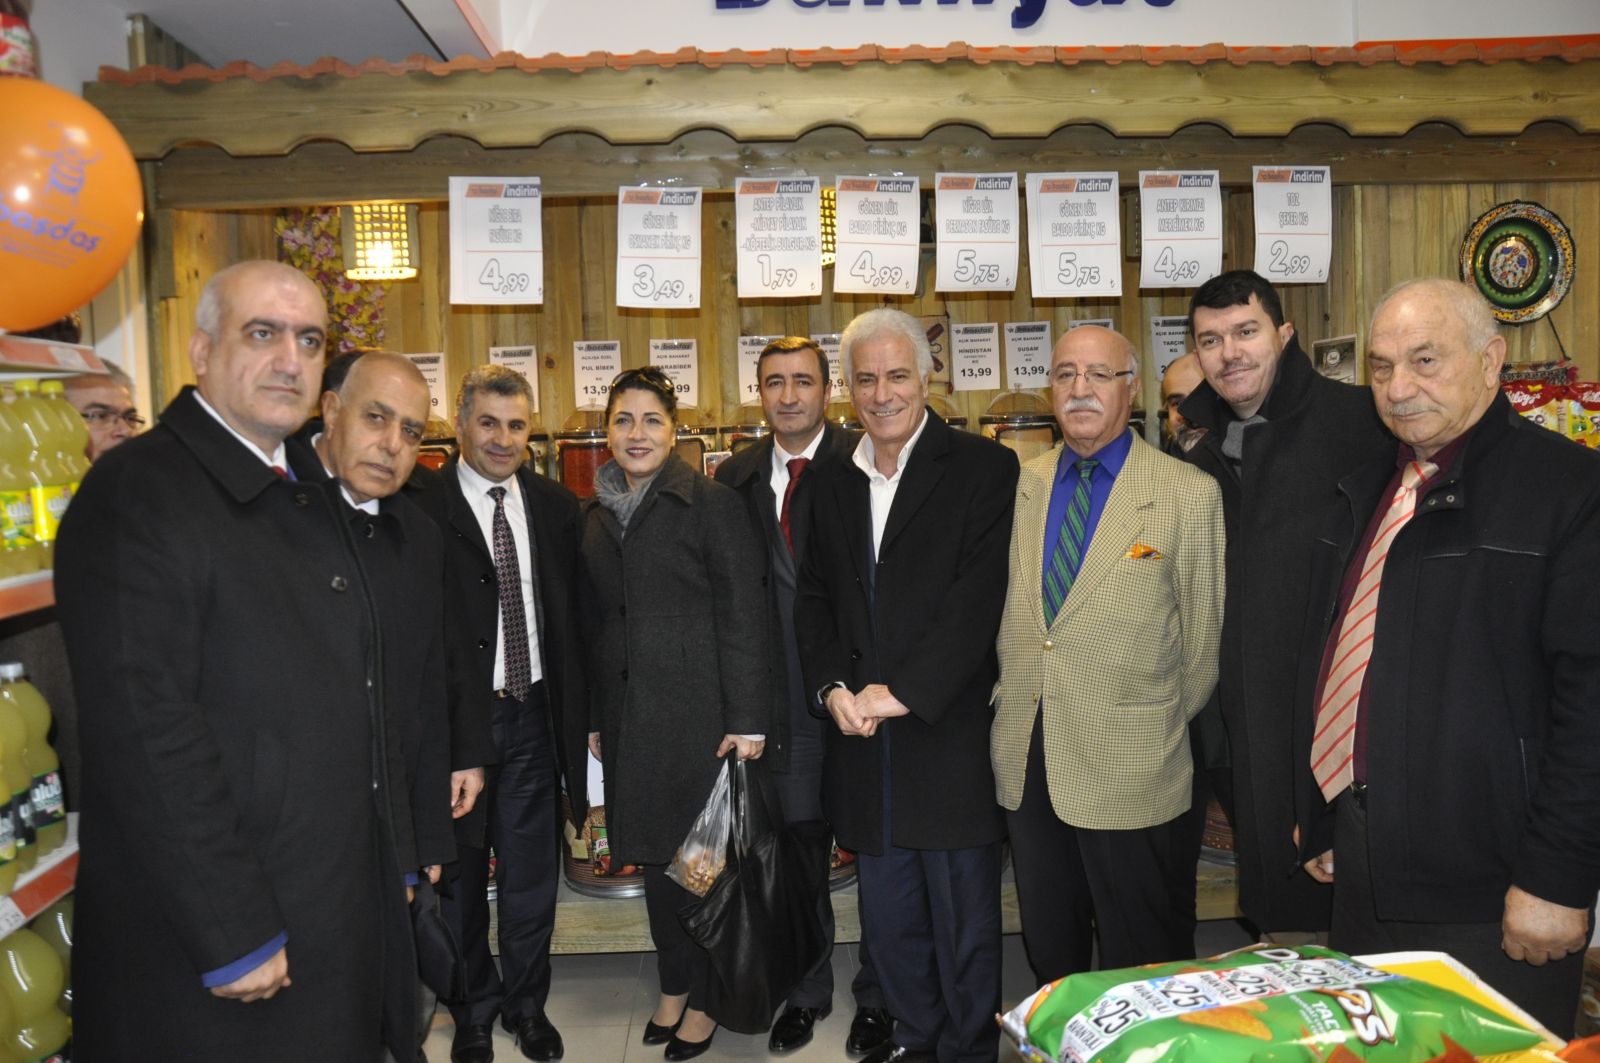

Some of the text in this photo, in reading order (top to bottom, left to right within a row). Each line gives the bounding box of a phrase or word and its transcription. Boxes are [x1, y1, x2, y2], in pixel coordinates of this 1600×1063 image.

[757, 254, 797, 290] 1,79
[850, 250, 902, 287] 4,99
[954, 249, 999, 285] 5,75
[1057, 252, 1101, 287] 5,75
[1154, 246, 1200, 281] 4,49
[1268, 240, 1310, 276] 2,99
[479, 258, 529, 295] 4,99
[632, 264, 684, 301] 3,49
[961, 367, 992, 378] 13,99
[1014, 366, 1045, 376] 13,99
[1160, 980, 1212, 1007] %25
[1227, 971, 1279, 995] %25
[1093, 999, 1143, 1034] %25
